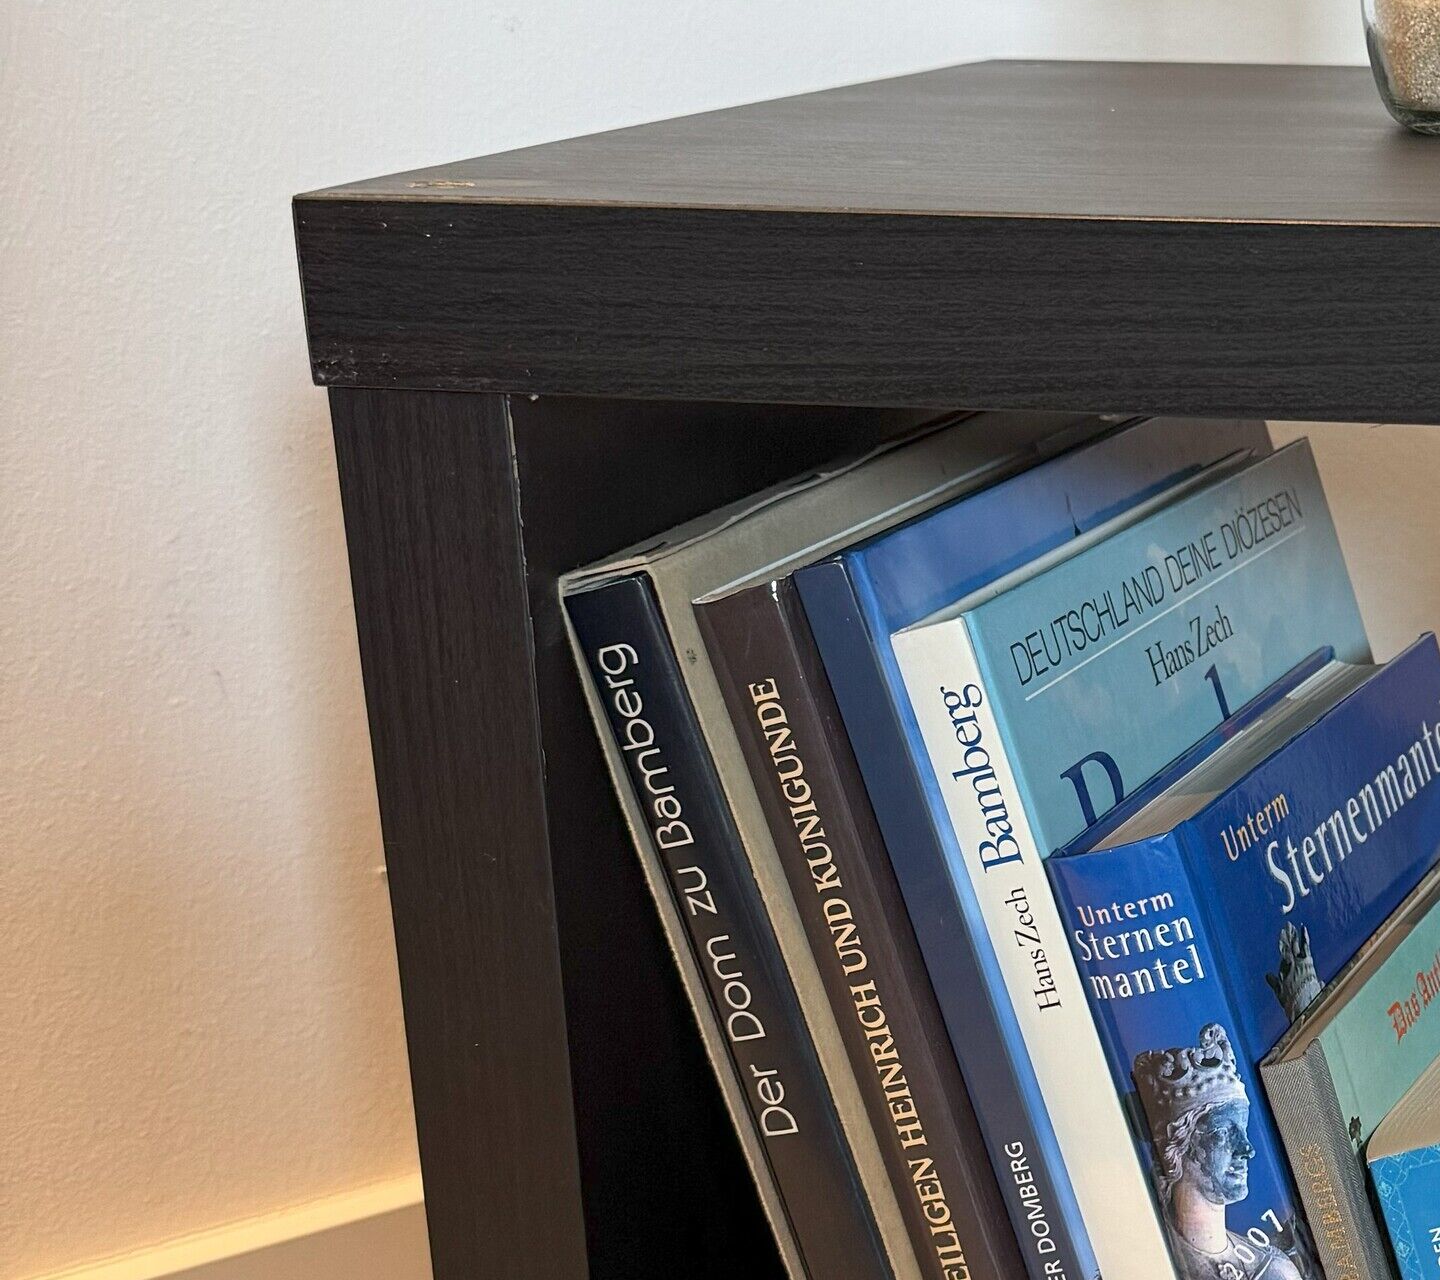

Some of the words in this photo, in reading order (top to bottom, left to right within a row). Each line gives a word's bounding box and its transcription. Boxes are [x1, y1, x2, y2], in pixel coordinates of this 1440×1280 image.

[1010, 566, 1164, 685] DEUTSCHLAND
[1165, 532, 1222, 592] DEINE
[1221, 488, 1302, 559] DIÖZESEN
[1145, 639, 1195, 686] Hans
[1190, 606, 1233, 657] Zech
[599, 643, 694, 849] Bamberg
[940, 684, 1024, 873] Bamberg
[748, 678, 842, 893] KUNIGUNDE
[1221, 793, 1290, 862] Unterm
[677, 865, 718, 917] zu
[1005, 887, 1040, 947] Zech
[1077, 891, 1174, 928] Unterm
[824, 898, 868, 976] UND
[1075, 916, 1194, 962] Sternen
[1089, 943, 1205, 1000] mantel
[706, 934, 766, 1042] Dom
[1031, 949, 1062, 1011] Hans
[1387, 994, 1421, 1044] Das
[750, 1064, 799, 1136] Der
[849, 980, 928, 1149] HEINRICH
[1005, 1140, 1056, 1254] DOMBERG
